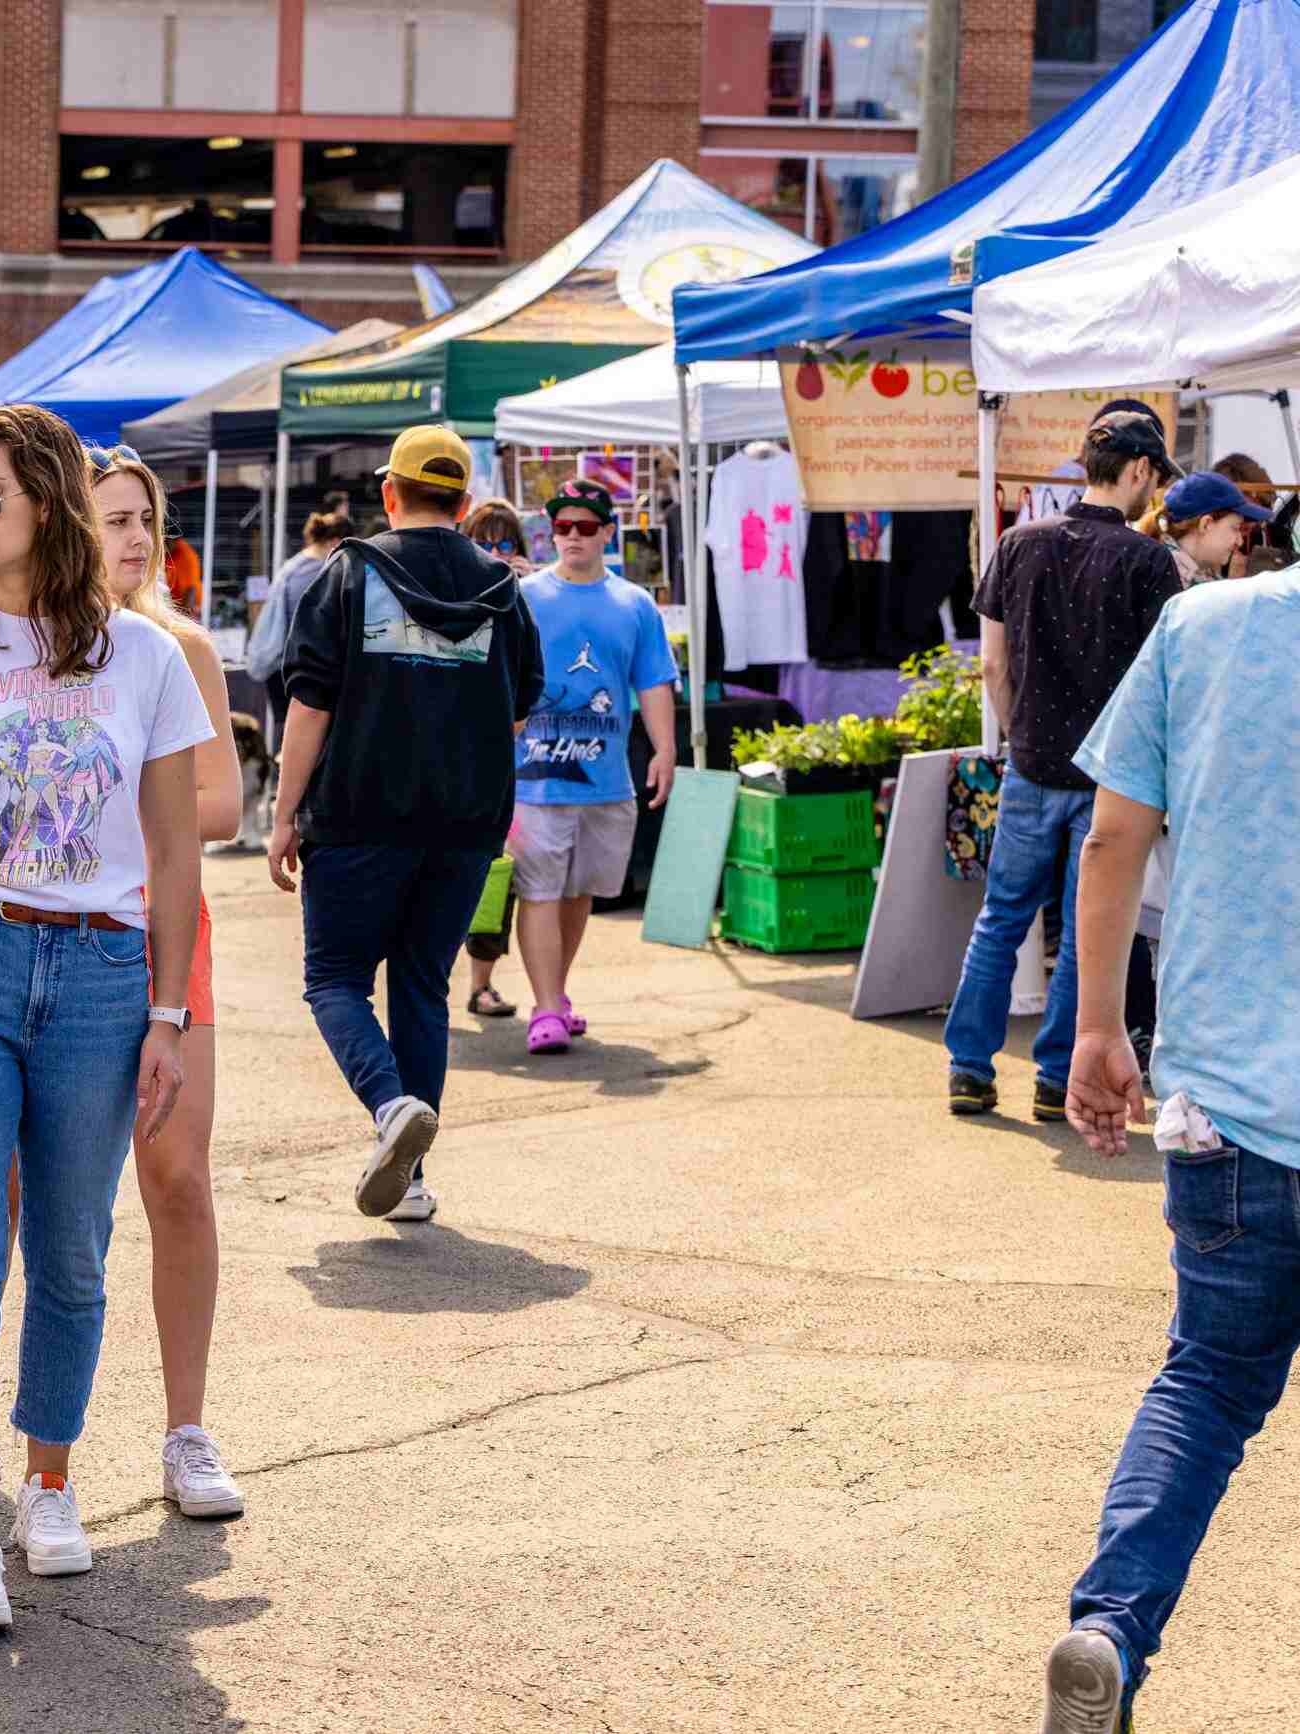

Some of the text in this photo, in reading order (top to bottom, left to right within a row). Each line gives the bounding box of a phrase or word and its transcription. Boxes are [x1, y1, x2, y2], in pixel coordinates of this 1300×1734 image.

[796, 413, 860, 430] organic
[862, 408, 929, 426] certified
[835, 433, 951, 453] pasture-raised
[802, 456, 858, 475] Twenty
[27, 685, 116, 724] WORLD
